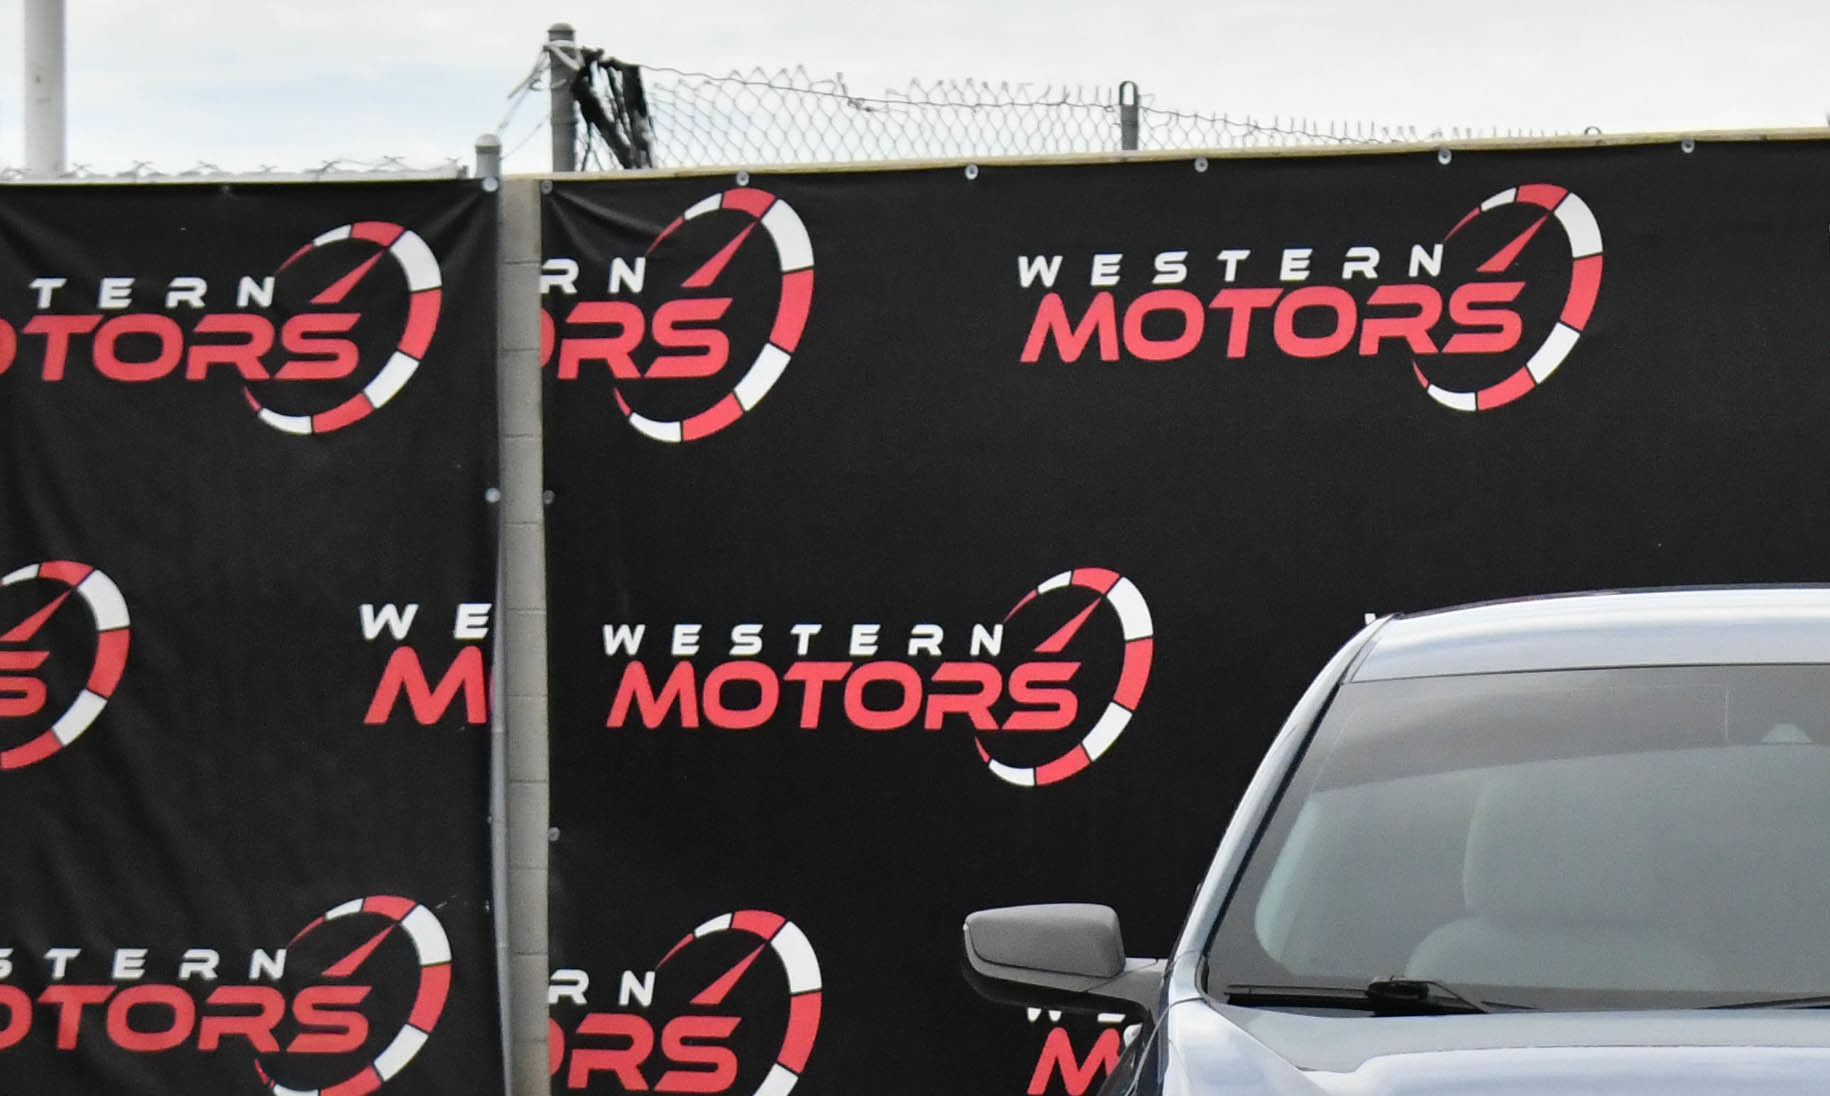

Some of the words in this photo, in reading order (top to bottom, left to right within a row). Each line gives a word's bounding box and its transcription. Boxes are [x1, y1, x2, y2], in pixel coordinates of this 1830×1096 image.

[1020, 245, 1444, 288] WESTERN
[0, 315, 361, 382] TORS
[541, 298, 733, 380] RS
[1022, 283, 1526, 363] MOTORS
[605, 625, 1003, 656] WESTERN
[608, 662, 1081, 731] MOTORS
[550, 1015, 741, 1094] RS
